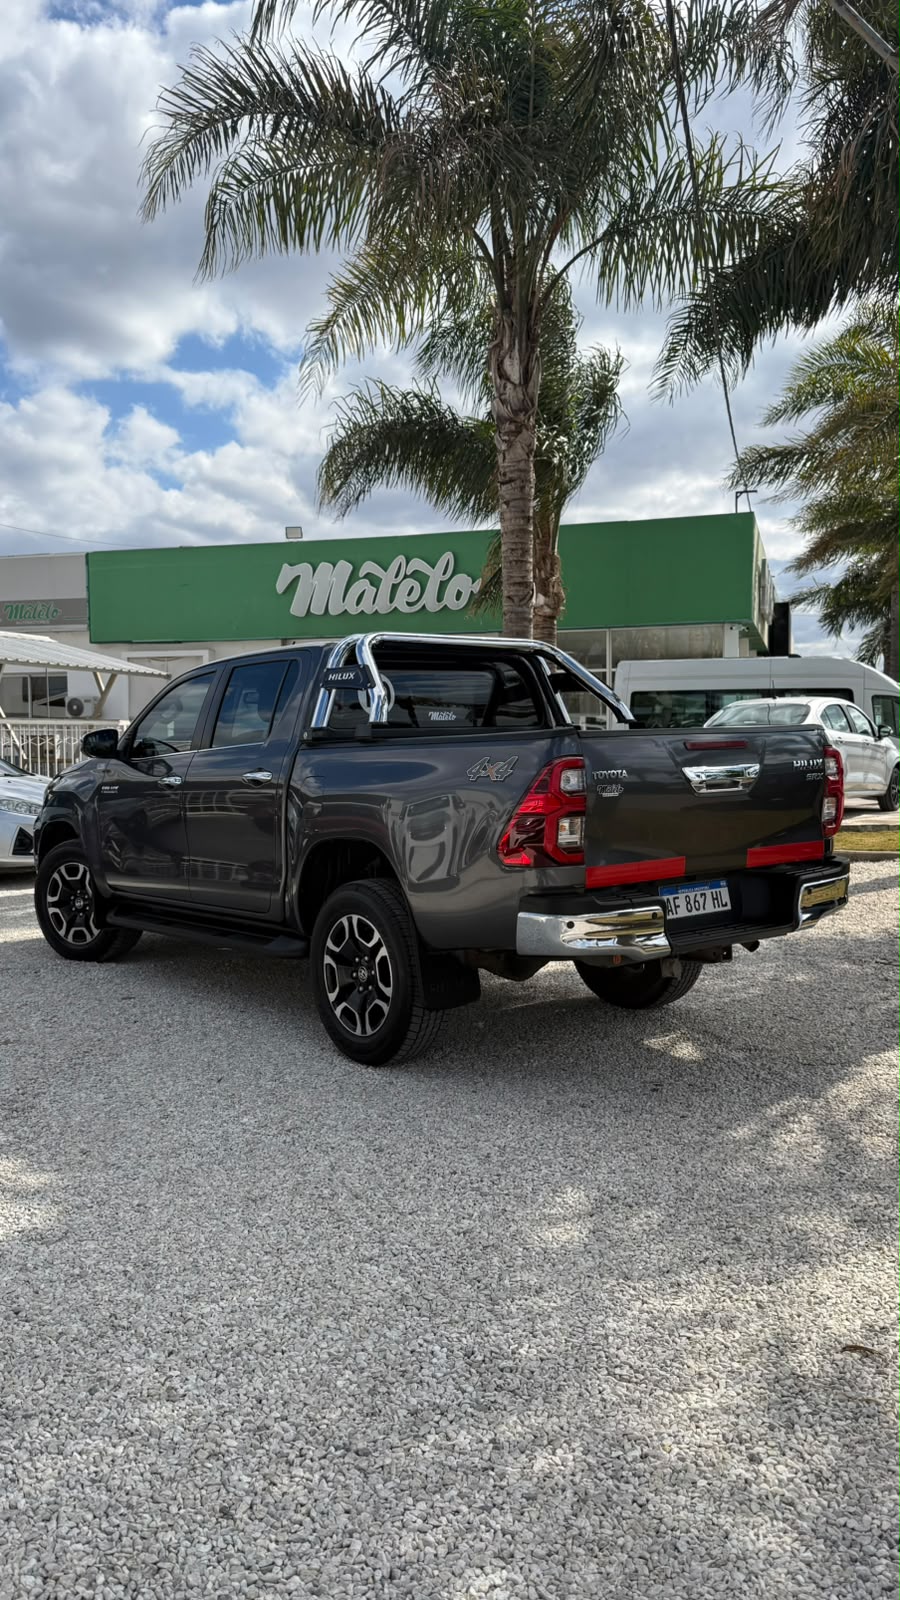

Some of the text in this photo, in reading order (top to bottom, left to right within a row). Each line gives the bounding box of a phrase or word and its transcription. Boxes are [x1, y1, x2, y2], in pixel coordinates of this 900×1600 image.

[328, 672, 356, 681] HILUX
[592, 769, 628, 780] TOYOTA
[806, 772, 824, 780] SRX
[666, 890, 728, 916] AF 867 HL
